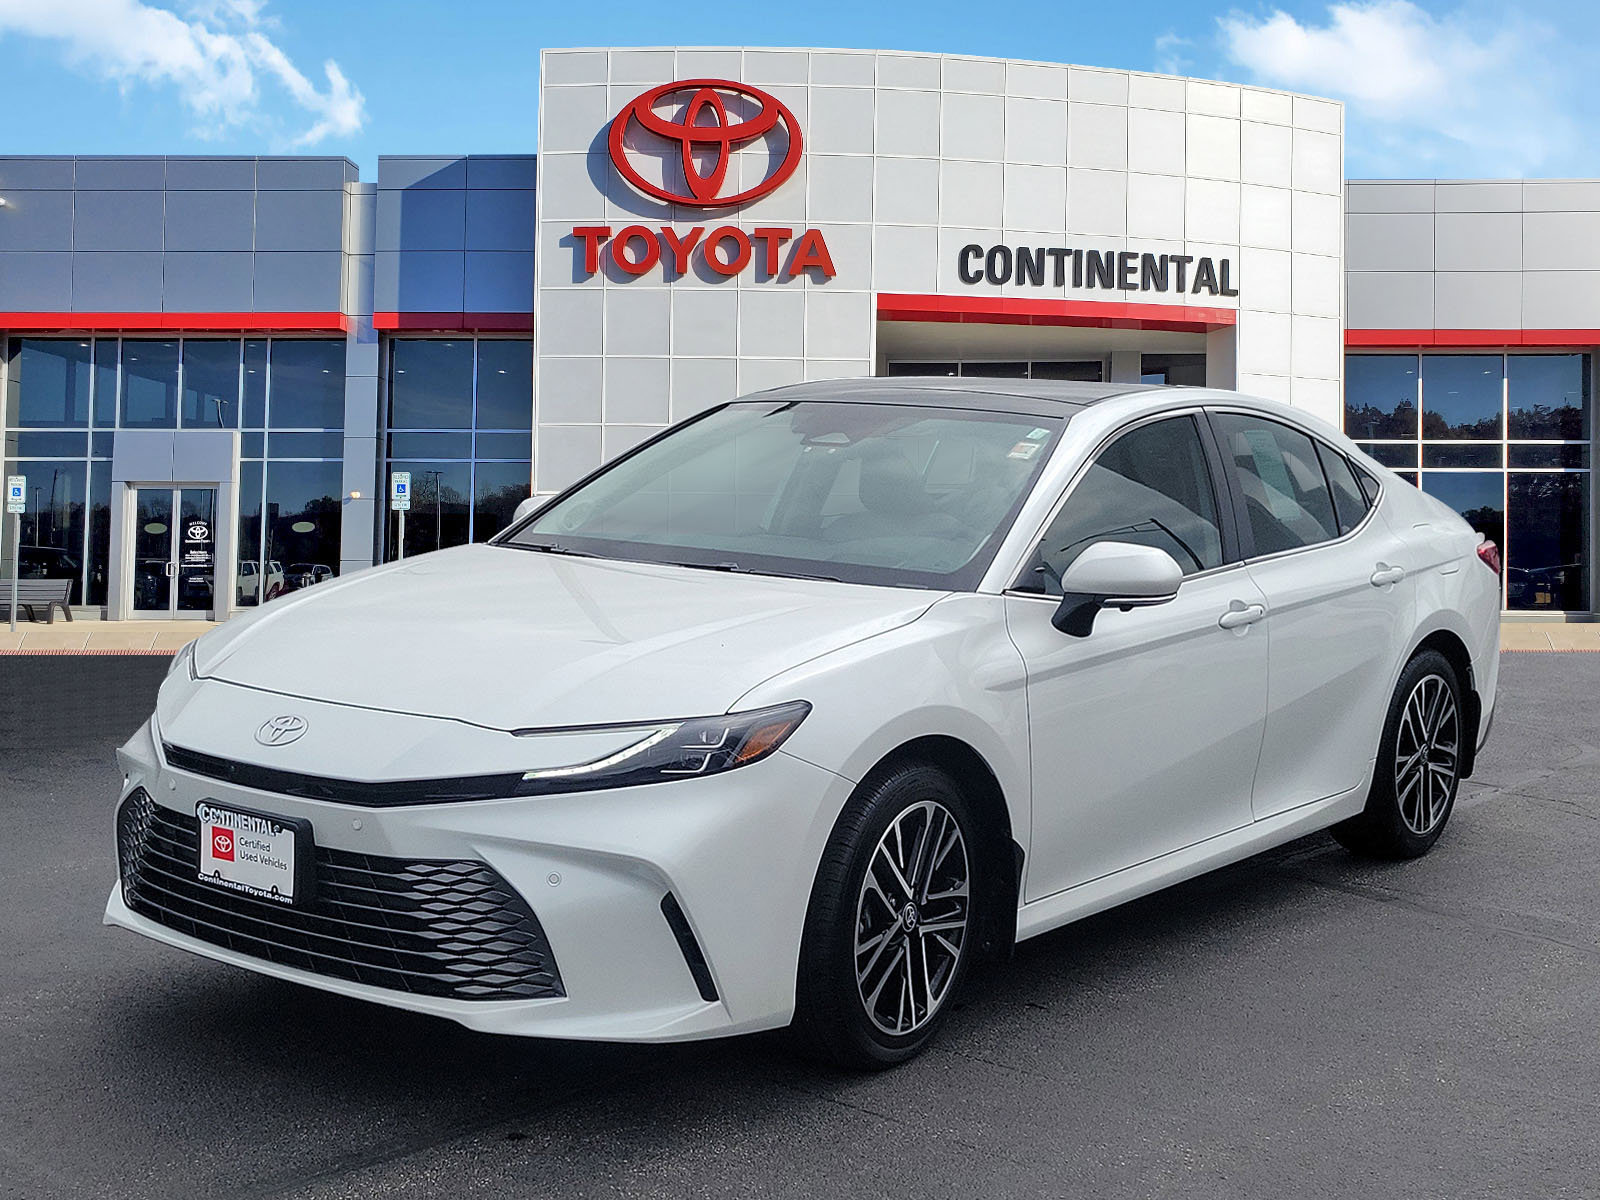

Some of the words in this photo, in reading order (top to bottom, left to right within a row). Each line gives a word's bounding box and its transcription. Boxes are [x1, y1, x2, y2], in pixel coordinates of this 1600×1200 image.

[572, 225, 837, 277] TOYOTA
[958, 244, 1239, 296] CONTINENTAL
[197, 803, 277, 837] CONTINENTAL
[239, 837, 271, 852] Certified
[239, 850, 258, 863] Used
[259, 854, 288, 870] Vehicles
[197, 873, 293, 904] ContinentalToyota.com
